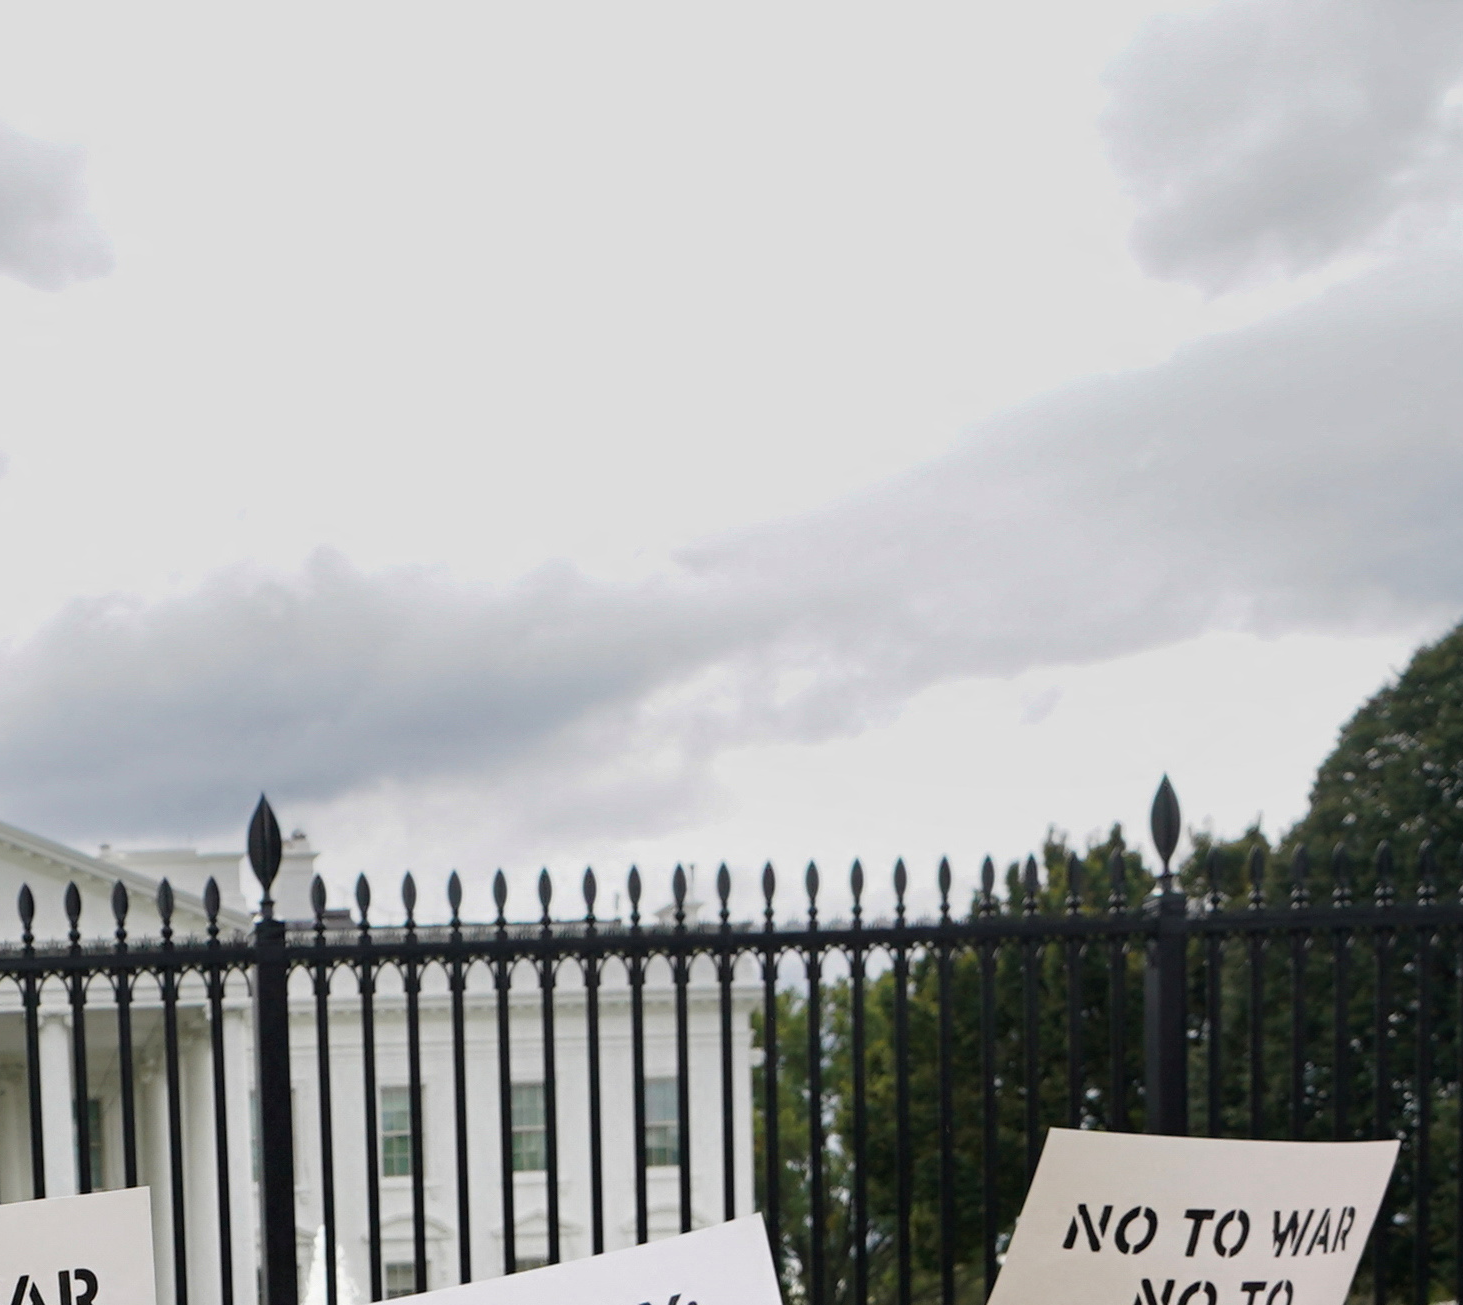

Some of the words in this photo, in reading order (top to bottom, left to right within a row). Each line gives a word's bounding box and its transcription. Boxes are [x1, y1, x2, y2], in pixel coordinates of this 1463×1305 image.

[1062, 1203, 1159, 1256] NO
[1184, 1208, 1251, 1259] TO
[1272, 1206, 1357, 1258] WAR
